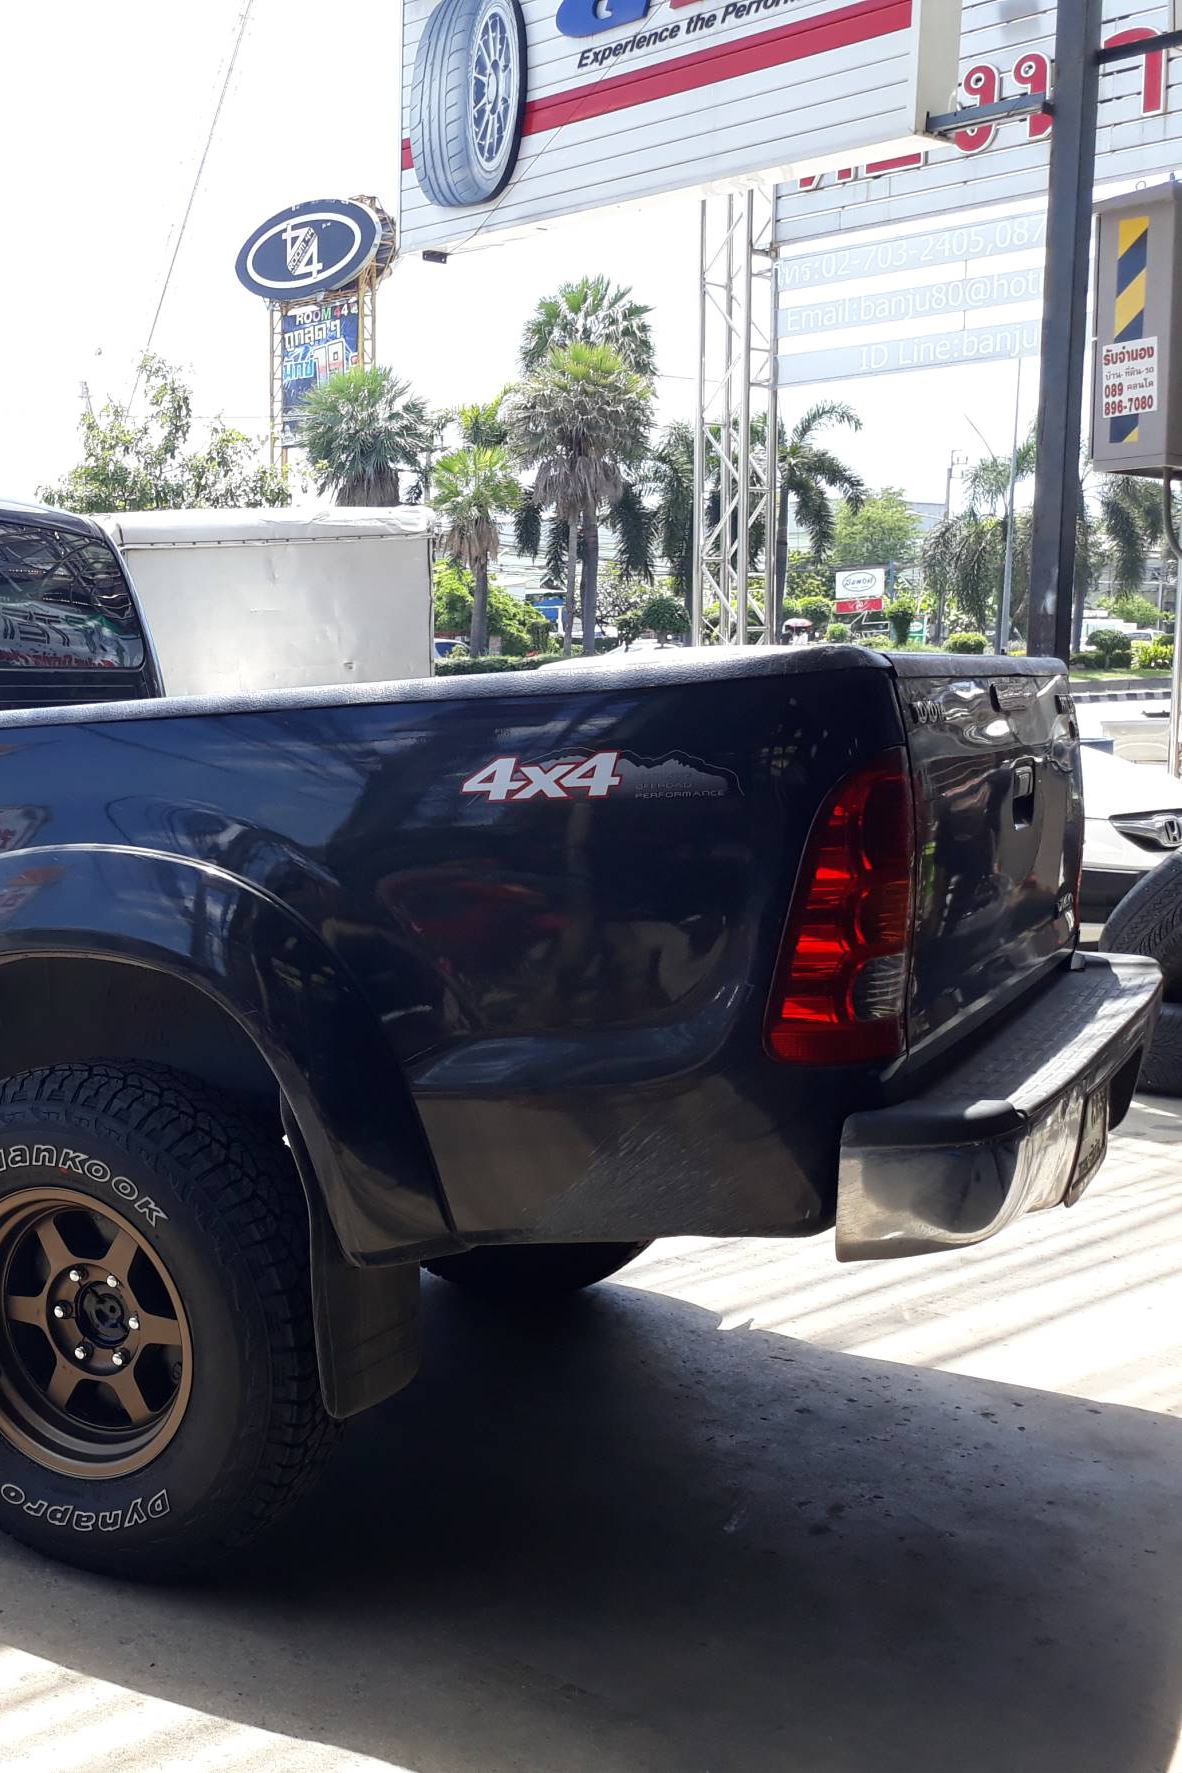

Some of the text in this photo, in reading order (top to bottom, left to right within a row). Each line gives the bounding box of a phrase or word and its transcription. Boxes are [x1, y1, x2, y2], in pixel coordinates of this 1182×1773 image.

[577, 23, 681, 70] Experience
[686, 11, 717, 36] the
[296, 307, 331, 326] ROOM
[859, 345, 890, 372] ID
[1104, 382, 1124, 399] 089
[1104, 394, 1154, 416] 896-7080
[462, 751, 620, 800] 4x4
